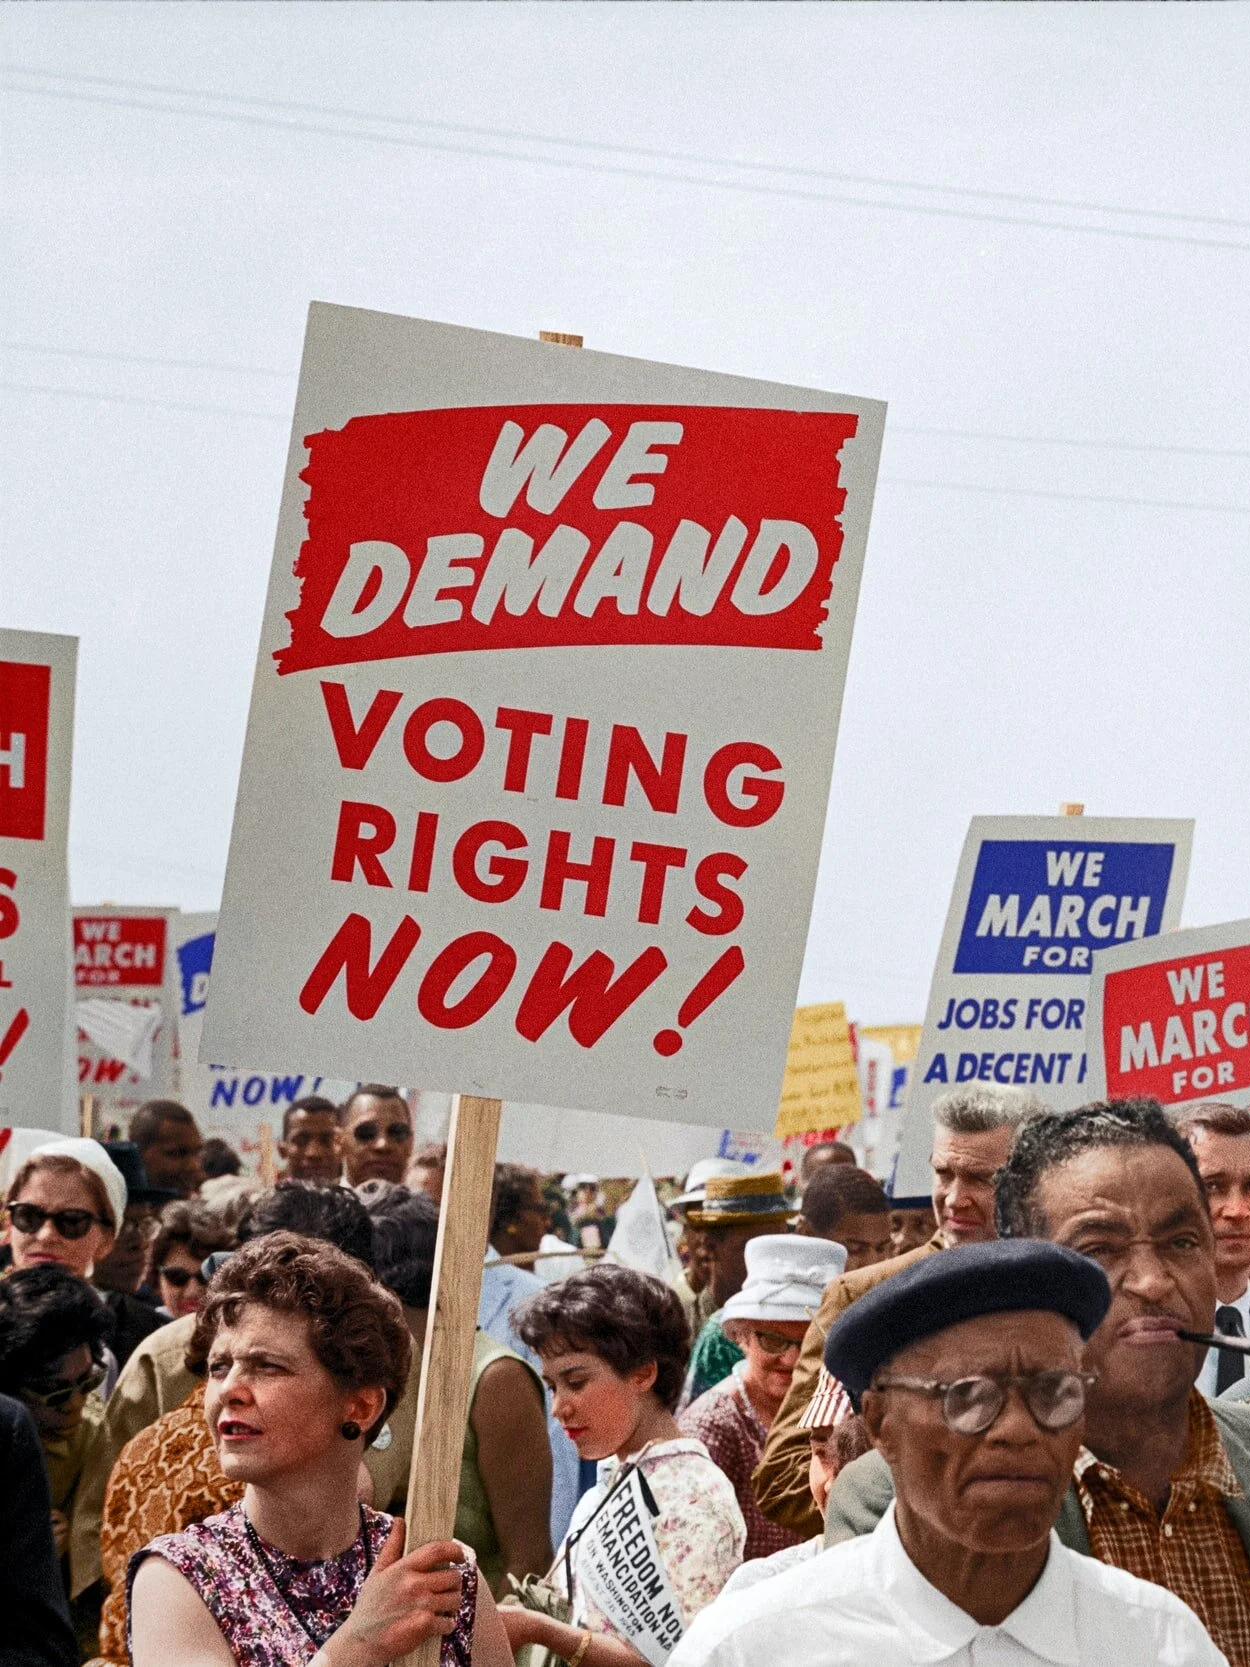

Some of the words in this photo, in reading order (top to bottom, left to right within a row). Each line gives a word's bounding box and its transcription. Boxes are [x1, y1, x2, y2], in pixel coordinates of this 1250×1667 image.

[480, 418, 684, 518] WE
[320, 514, 818, 638] DEMAND
[320, 681, 785, 827] VOTING
[330, 800, 749, 936] RIGHTS
[1046, 851, 1104, 887] WE
[80, 921, 122, 942] WE
[976, 894, 1150, 938] MARCH
[299, 913, 745, 1057] NOW!
[1023, 947, 1088, 967] FOR
[1167, 962, 1225, 1005] WE
[937, 998, 1016, 1029] JOBS
[1025, 999, 1085, 1029] FOR
[923, 1053, 953, 1083] A
[956, 1053, 1071, 1084] DECENT
[1172, 1062, 1235, 1094] FOR
[611, 1481, 664, 1600] FREEDOM
[596, 1510, 661, 1633] EMANCIPATION
[596, 1562, 644, 1633] WASHINGTON
